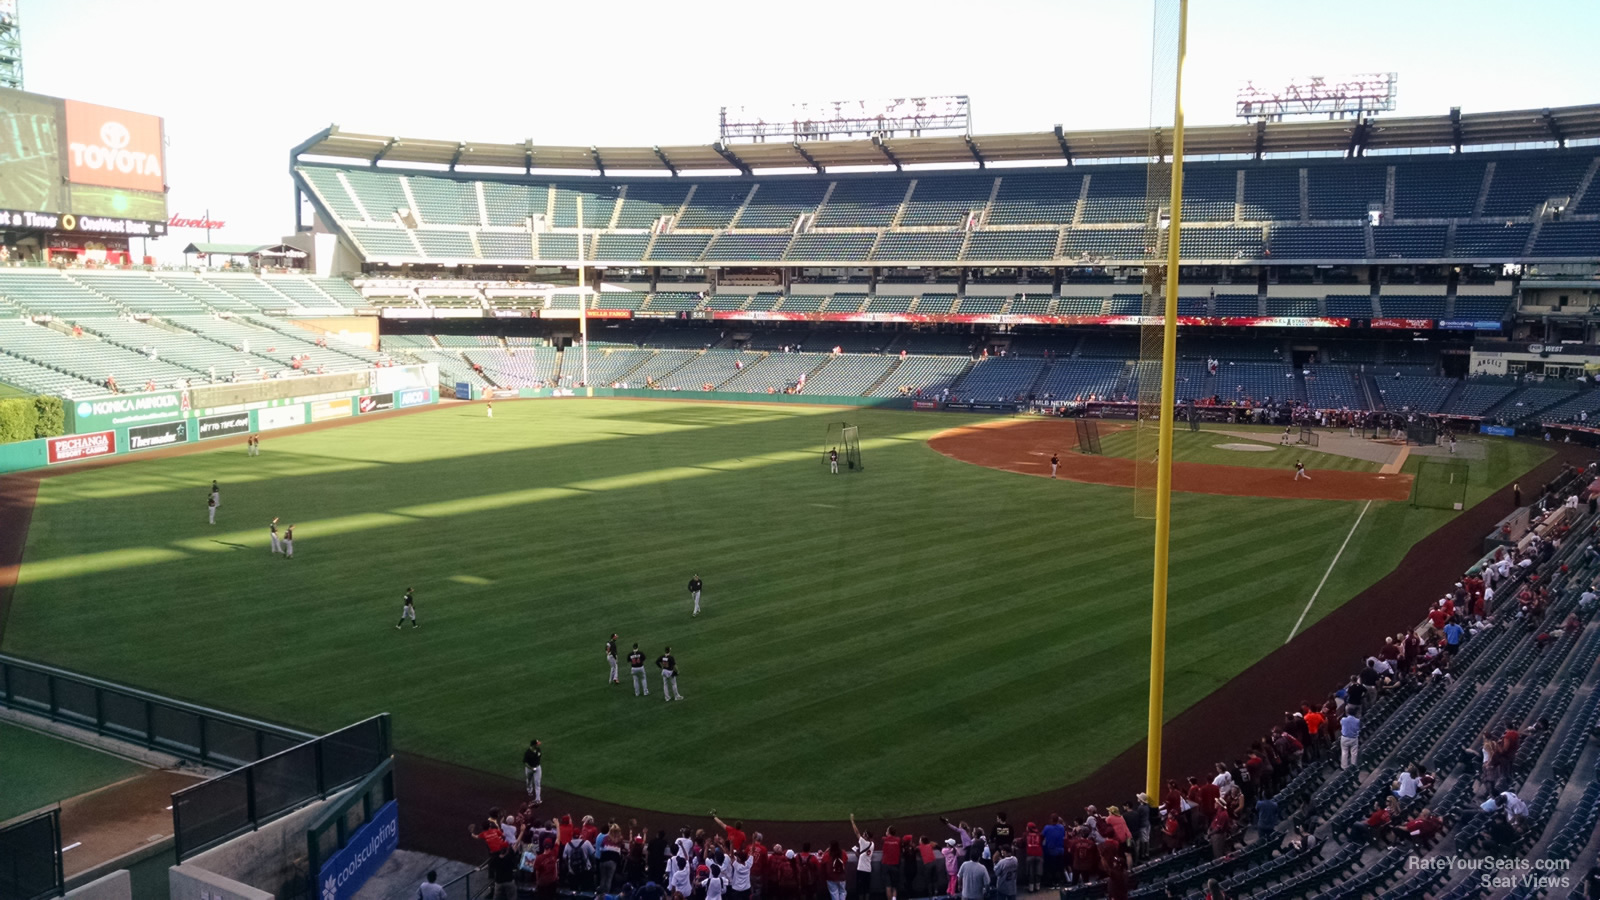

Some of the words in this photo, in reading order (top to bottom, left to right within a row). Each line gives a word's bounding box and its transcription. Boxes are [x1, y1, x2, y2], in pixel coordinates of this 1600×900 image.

[69, 142, 162, 176] TOYOTA
[168, 213, 225, 229] dweiser
[1477, 358, 1502, 368] ANGELS
[93, 399, 135, 415] KONICA
[55, 434, 109, 451] PECHANGA
[337, 819, 396, 887] coolsculpting
